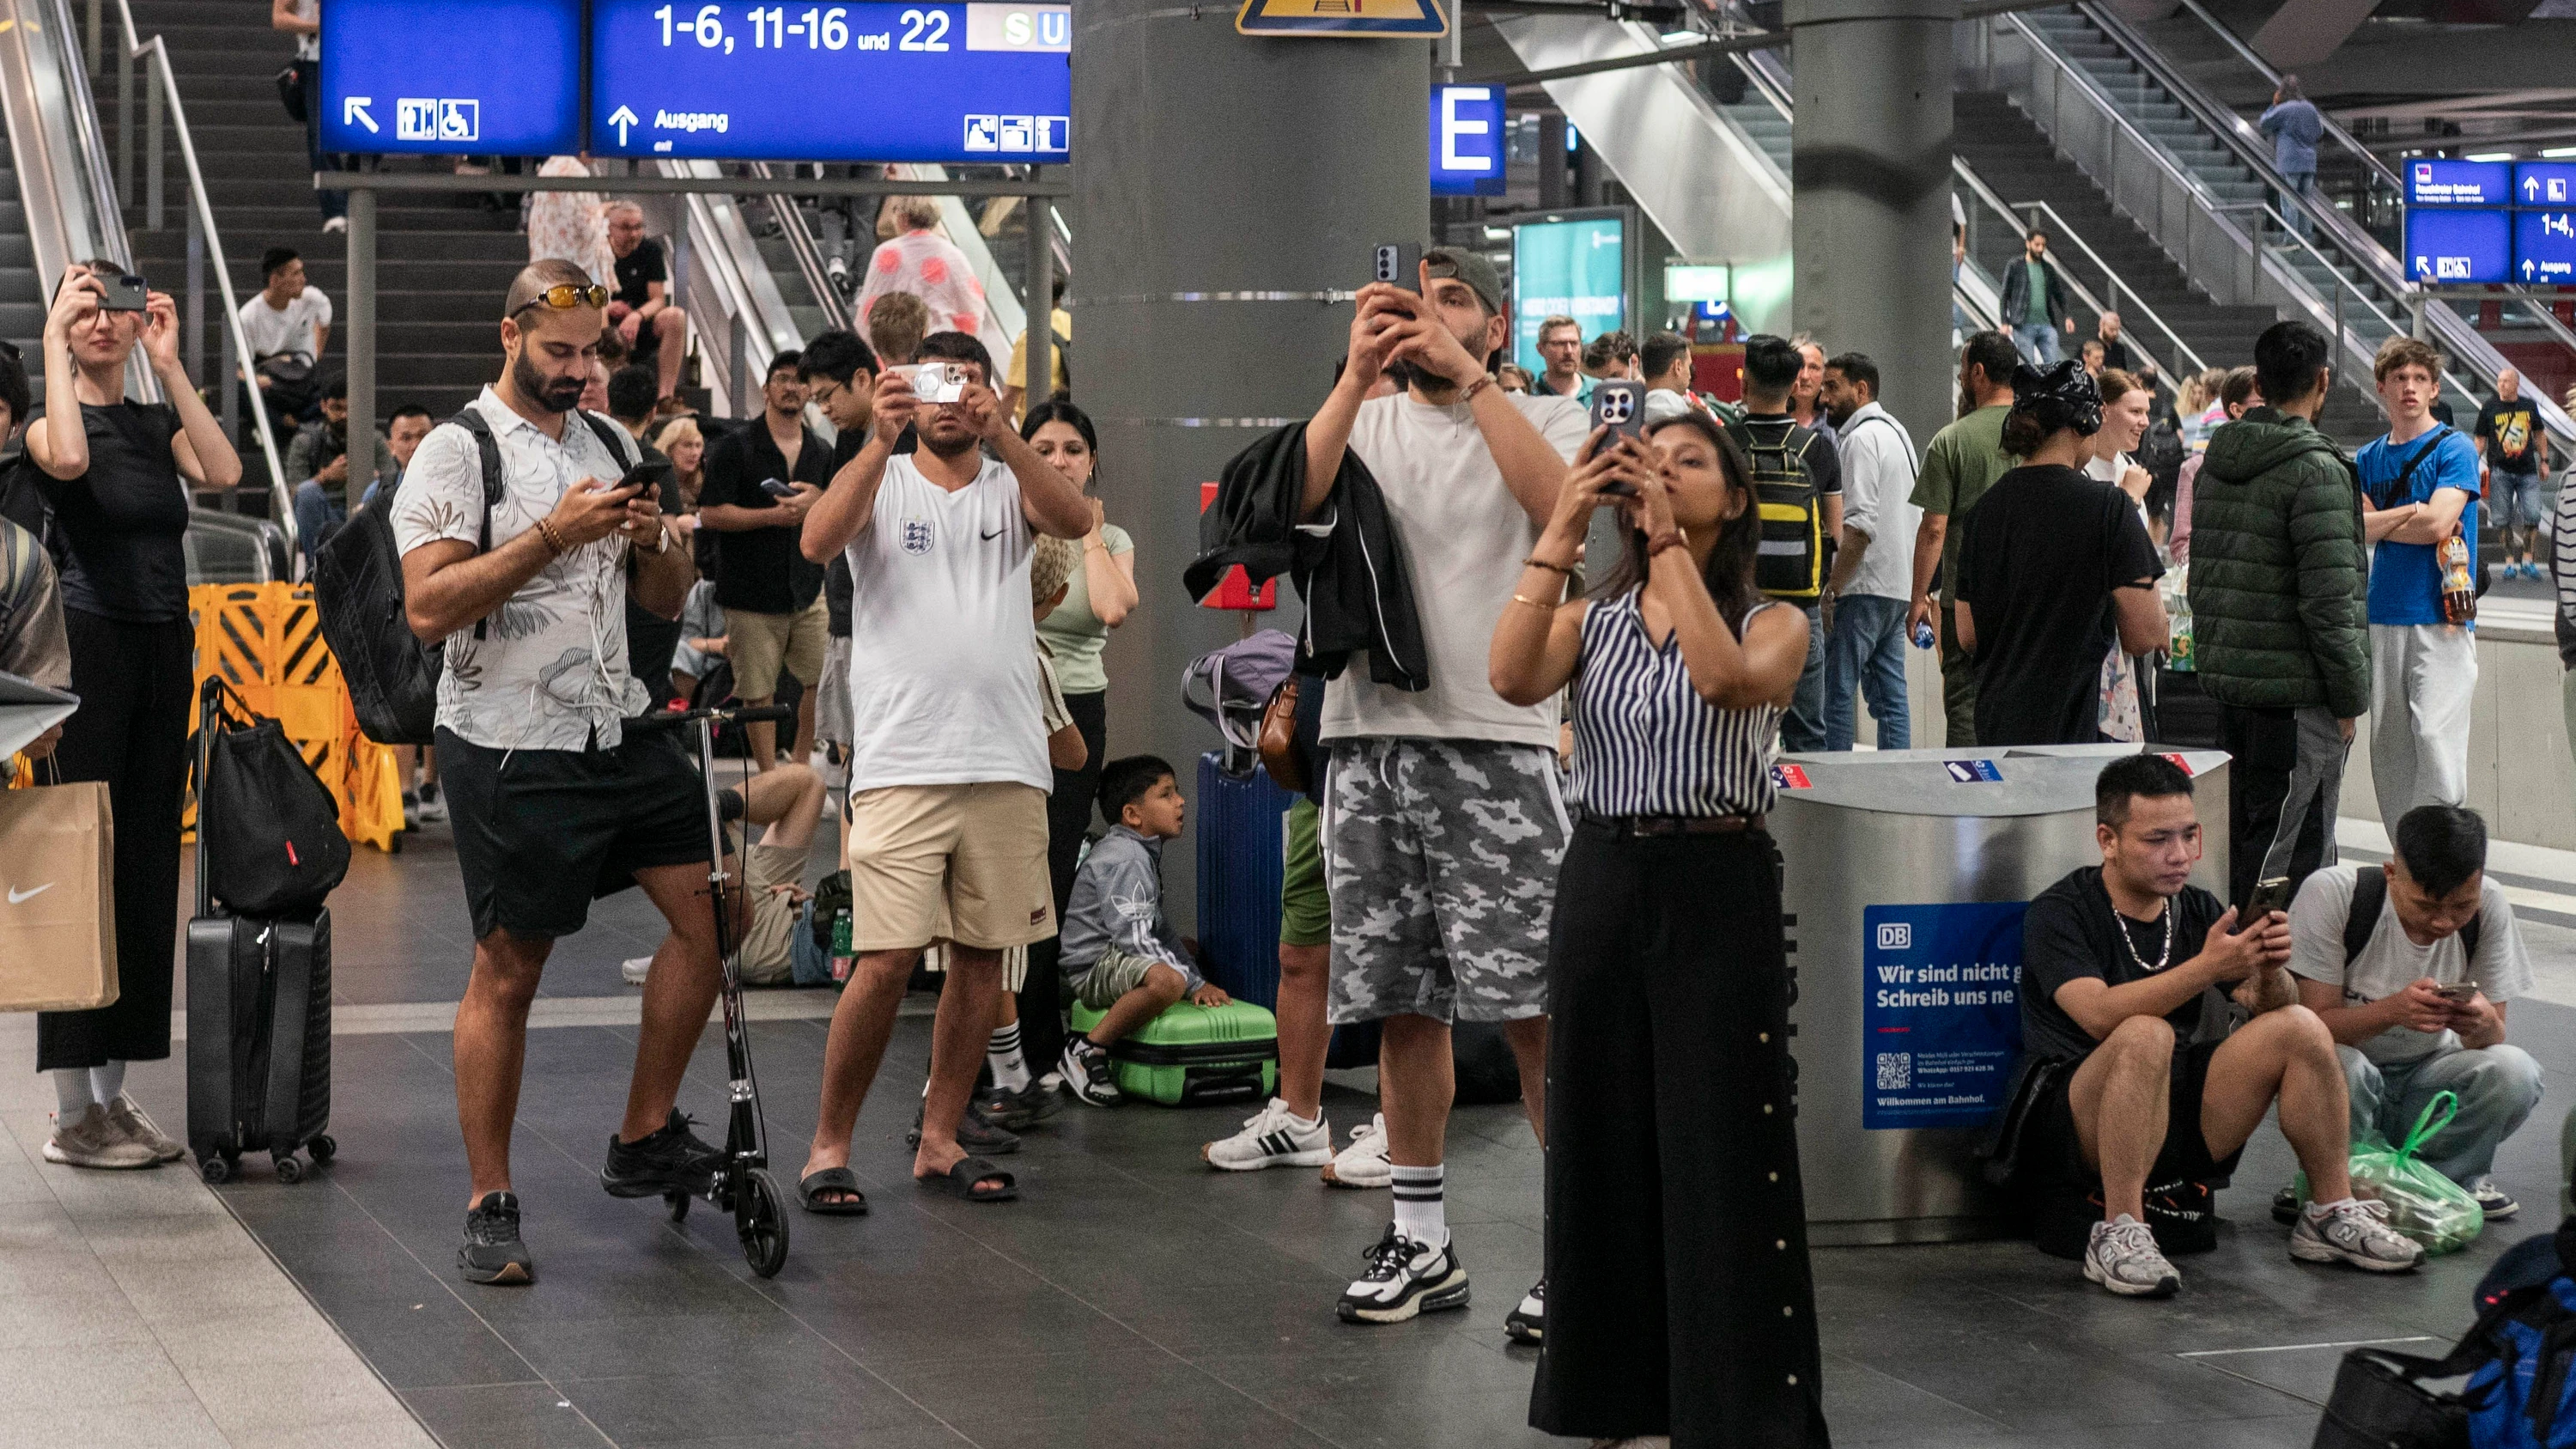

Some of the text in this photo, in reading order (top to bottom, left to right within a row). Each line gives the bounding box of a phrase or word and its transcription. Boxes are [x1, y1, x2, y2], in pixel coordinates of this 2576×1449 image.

[654, 4, 1065, 55] 1-6, 11-16 und 22 S U
[653, 109, 729, 133] Ausgang
[1442, 87, 1492, 170] E
[653, 140, 672, 152] exit
[2542, 213, 2574, 239] 1-4,
[2541, 260, 2572, 274] Ausgang
[1881, 928, 1907, 945] DB
[1877, 965, 1914, 983] Wir
[1917, 964, 1958, 983] sind
[1963, 962, 2009, 982] nicht
[1877, 988, 2014, 1008] Schreib uns ne
[1877, 1097, 1932, 1107] Willkommen
[1947, 1093, 1985, 1105] Bahnhof.
[2336, 1224, 2359, 1242] N
[2103, 1245, 2117, 1264] N
